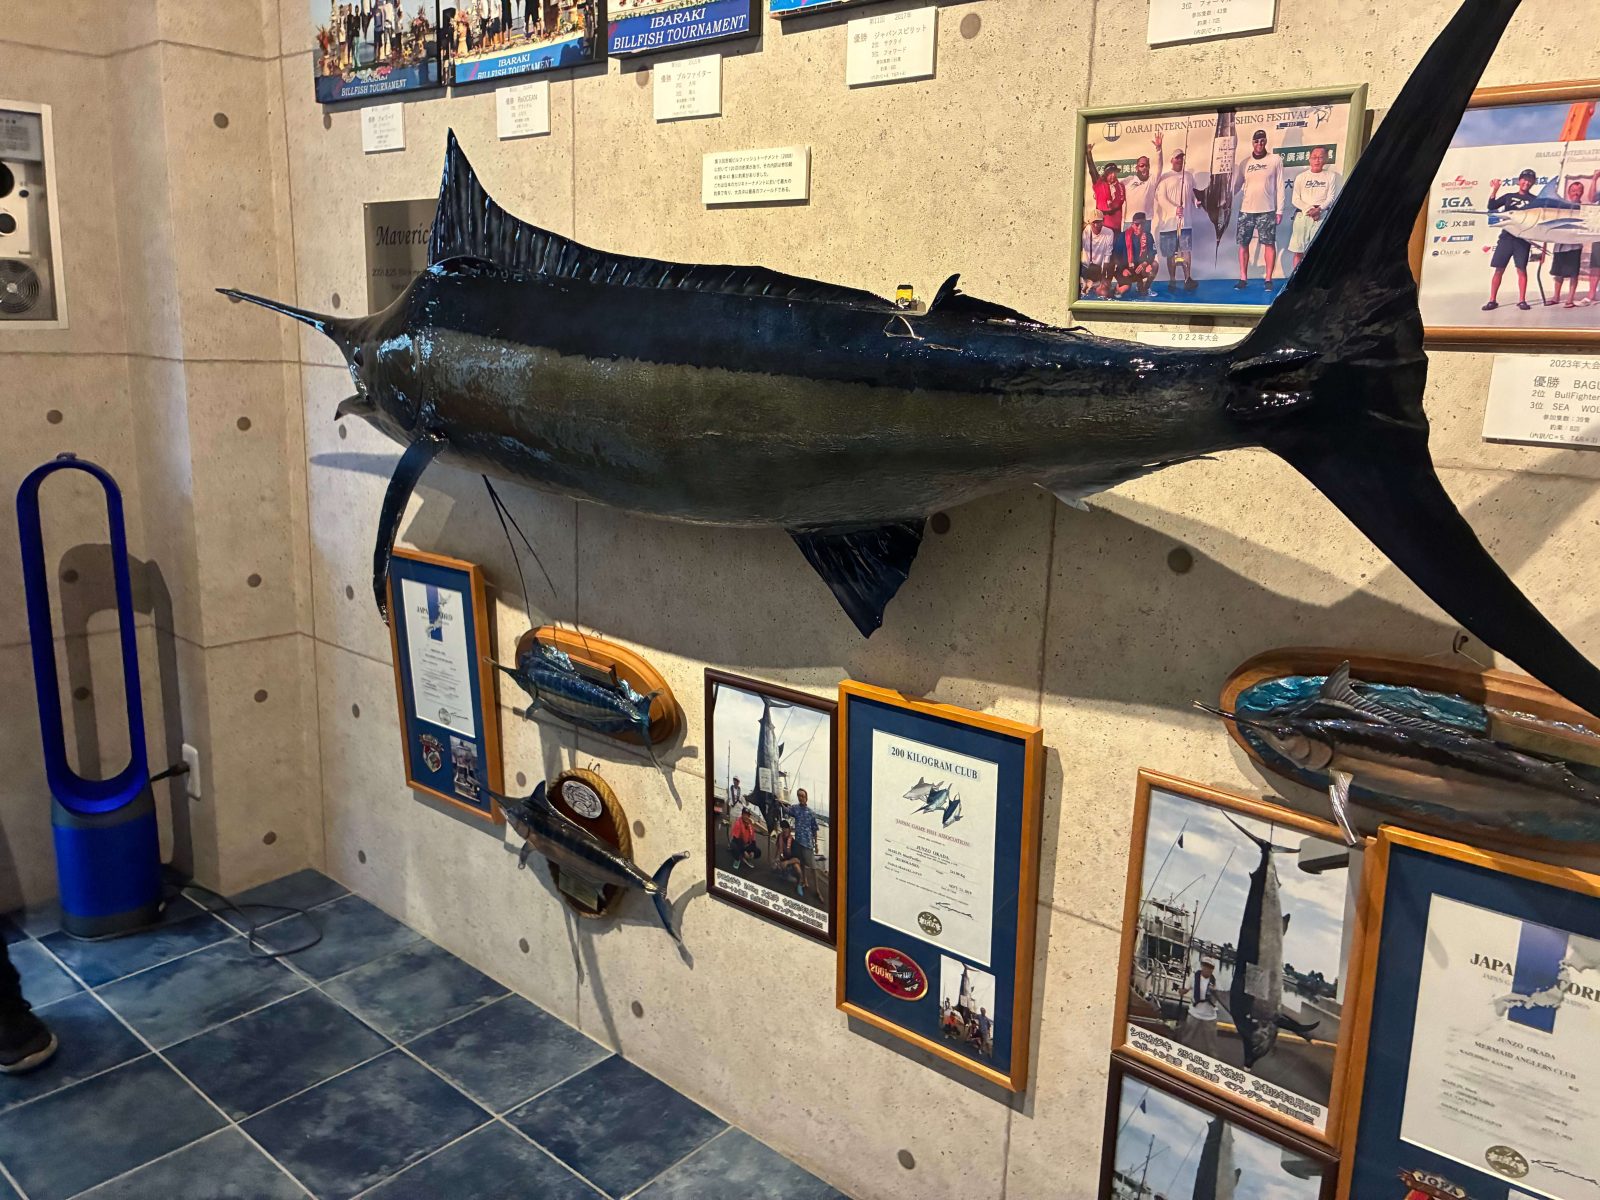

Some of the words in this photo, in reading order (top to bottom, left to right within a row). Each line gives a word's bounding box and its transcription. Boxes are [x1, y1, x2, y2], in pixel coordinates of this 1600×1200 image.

[650, 7, 707, 29] IBARAKI
[613, 30, 664, 50] BILLFISH
[667, 14, 747, 42] TOURNAMENT
[498, 54, 530, 67] IBARAKI
[341, 85, 368, 97] BILLFISH
[370, 79, 407, 94] TOURNAMENT
[1125, 124, 1153, 134] OARAI
[1154, 118, 1217, 132] INTERNATION
[1235, 114, 1264, 125] SHING
[1266, 111, 1309, 122] FESTIVAL
[1441, 197, 1473, 208] IGA
[376, 222, 429, 246] Maveric
[1171, 333, 1219, 342] 2022年大会
[1533, 376, 1560, 388] 優勝
[1531, 390, 1545, 398] 2位
[1554, 391, 1600, 401] BullFighter
[1530, 402, 1544, 410] 3位
[1552, 403, 1570, 411] SEA
[891, 746, 905, 758] 200
[907, 751, 952, 773] KILOGRAM
[954, 765, 978, 780] CLUB
[1470, 953, 1513, 976] JAPA
[1557, 979, 1600, 1003] COR
[1474, 1041, 1514, 1059] MERMAID
[1515, 1054, 1552, 1072] ANGLERS
[1553, 1068, 1577, 1080] CLUB
